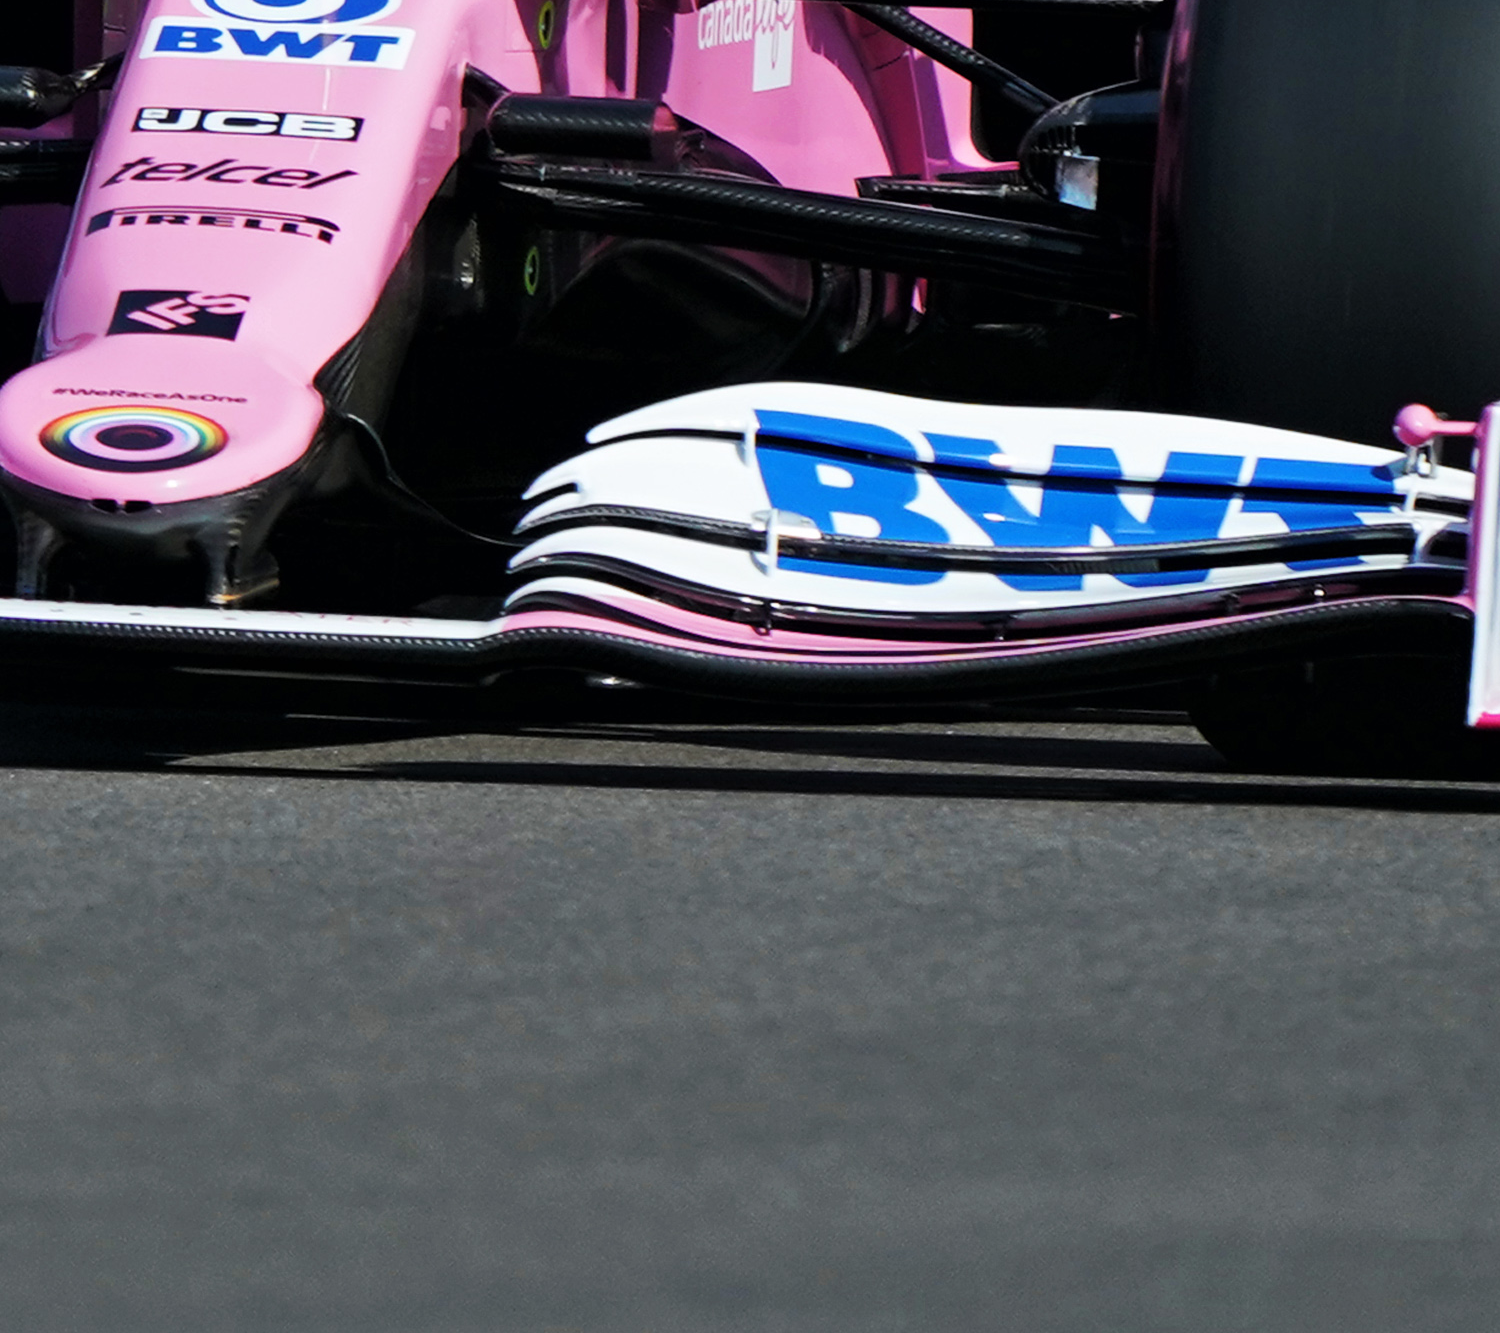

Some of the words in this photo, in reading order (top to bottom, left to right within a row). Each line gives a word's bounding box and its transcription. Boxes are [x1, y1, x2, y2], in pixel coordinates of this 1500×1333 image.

[153, 25, 400, 63] BWT
[136, 108, 358, 141] JCB
[99, 156, 361, 189] telcel
[85, 205, 341, 245] PIRELLI
[126, 291, 252, 331] IFS
[52, 387, 248, 404] #WeRaceAsOne
[753, 409, 1410, 589] BWT
